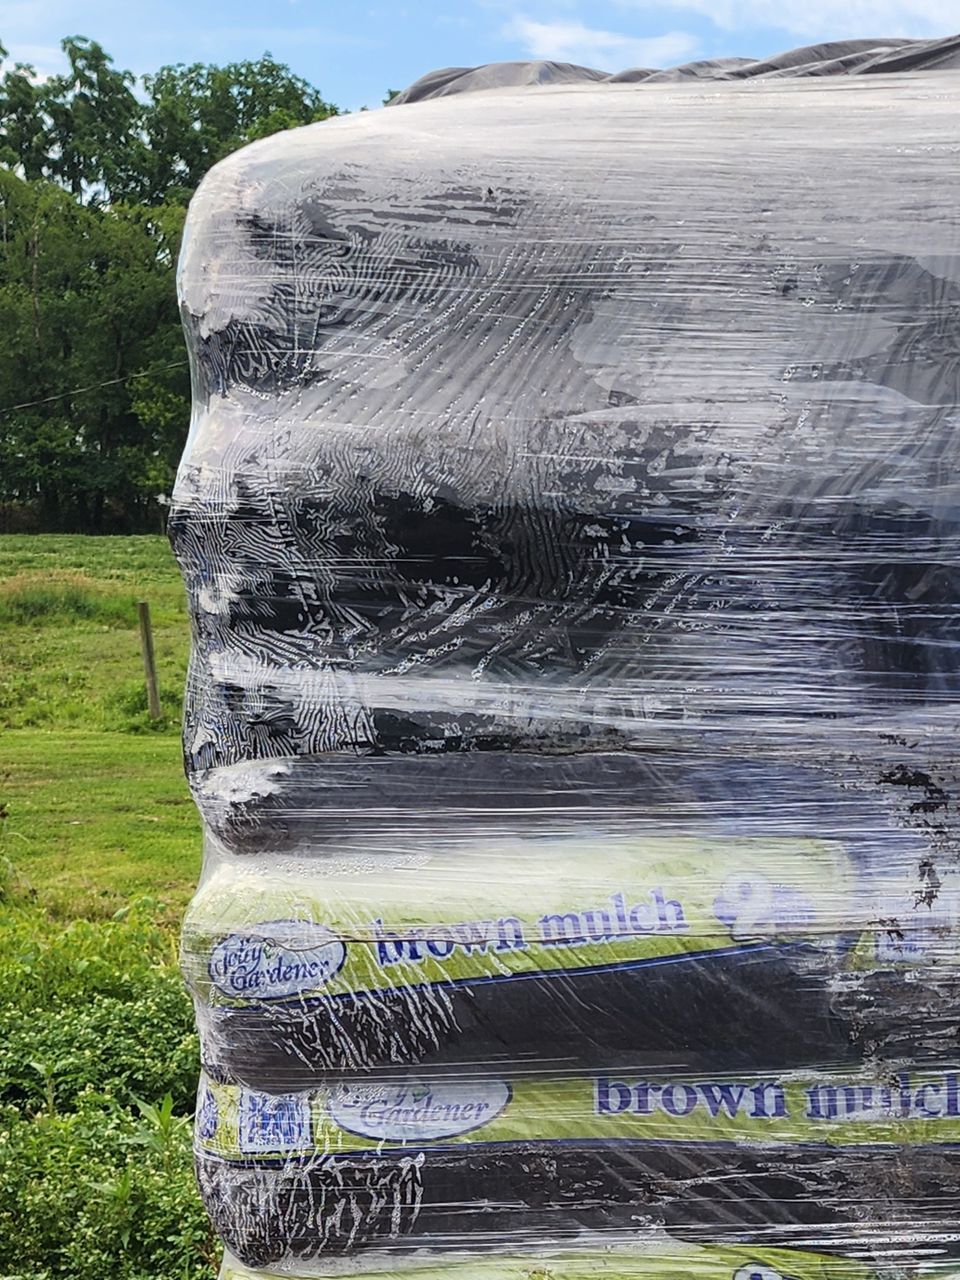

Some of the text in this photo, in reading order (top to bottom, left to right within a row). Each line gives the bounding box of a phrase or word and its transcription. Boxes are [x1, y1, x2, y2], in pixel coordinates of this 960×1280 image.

[375, 886, 690, 966] brown mulch
[596, 1076, 788, 1119] brown
